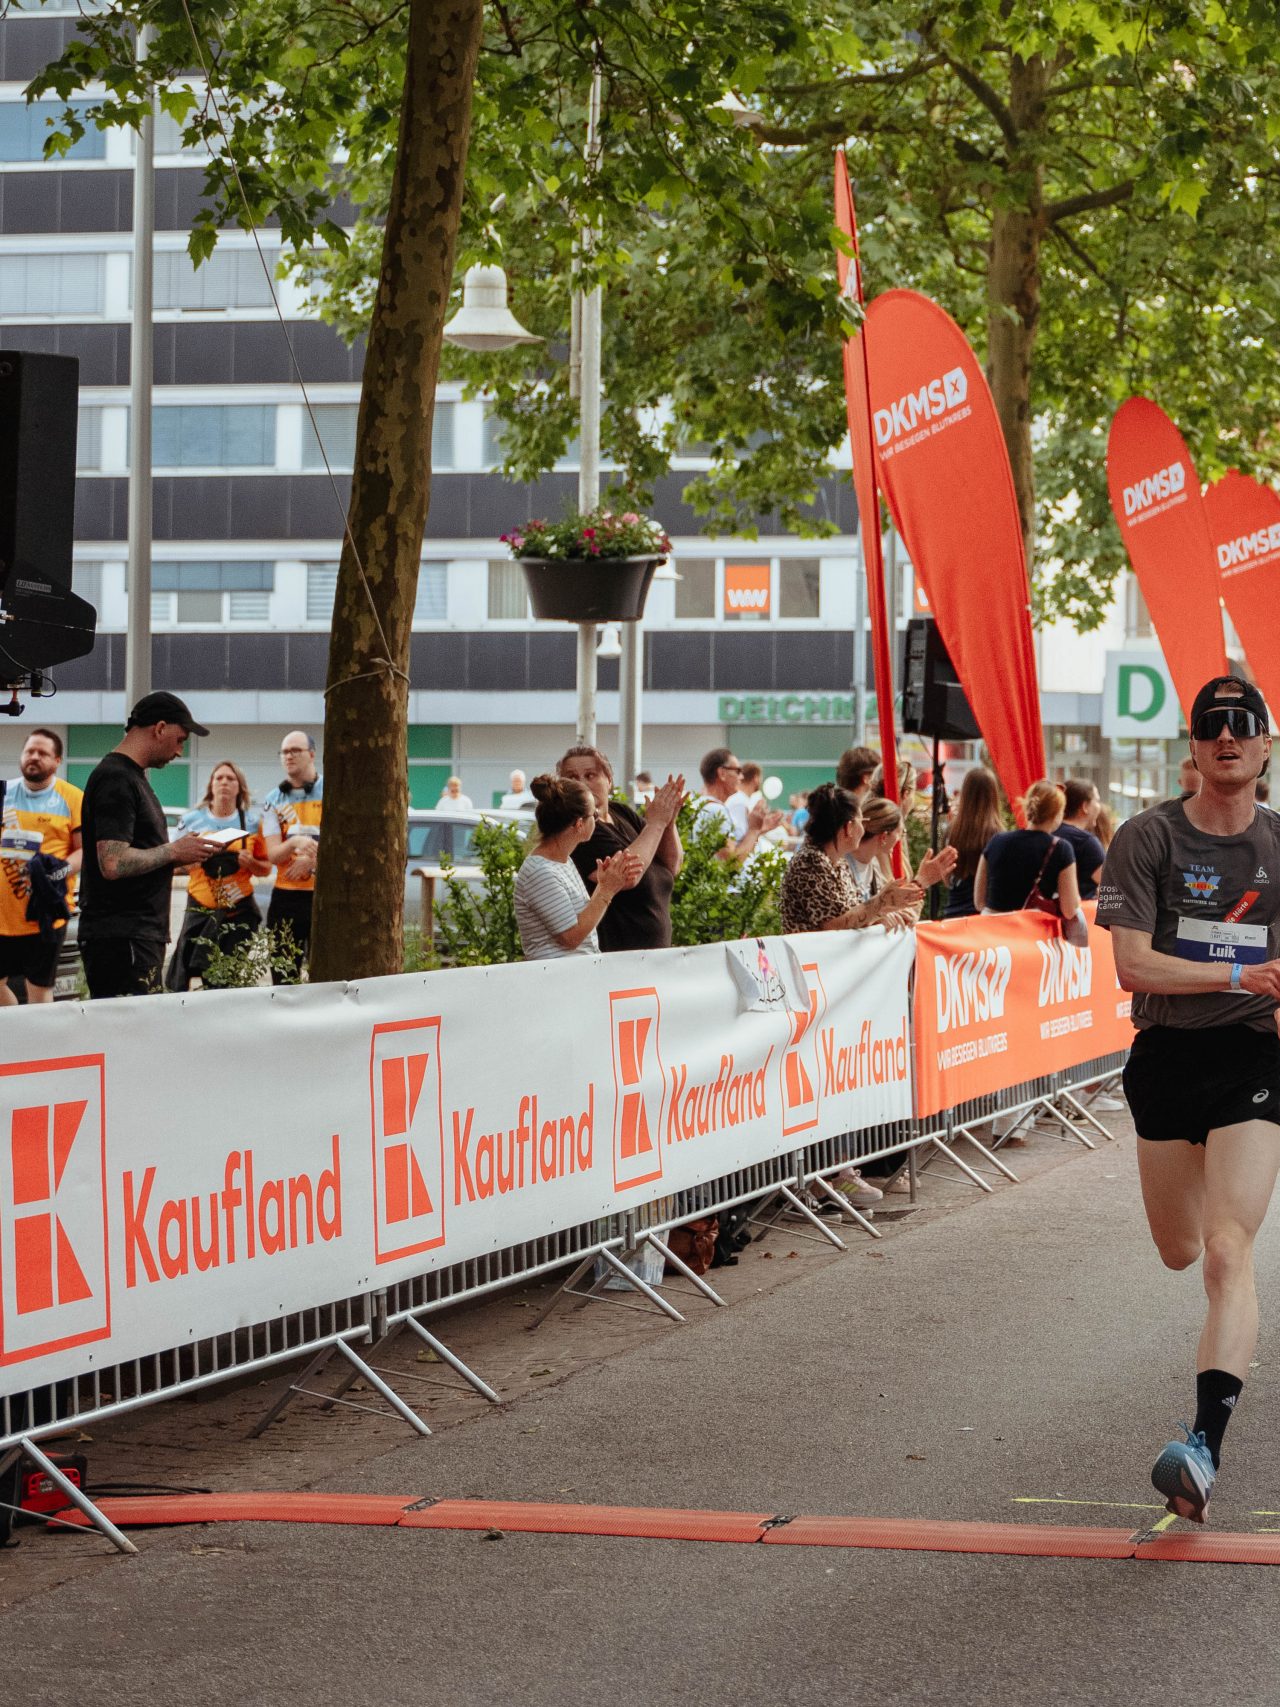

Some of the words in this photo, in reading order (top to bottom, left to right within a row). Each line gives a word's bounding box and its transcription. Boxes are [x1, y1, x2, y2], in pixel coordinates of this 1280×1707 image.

[873, 379, 946, 446] DKMS
[1123, 468, 1171, 516] DKMS
[1217, 529, 1270, 569] DKMS
[1117, 665, 1167, 722] D
[1189, 864, 1215, 873] TEAM
[1098, 902, 1123, 910] cancer
[1036, 939, 1080, 1008] DKMS
[1208, 944, 1237, 959] Luik
[934, 948, 993, 1034] DKMS
[822, 1015, 908, 1098] Kaufland
[667, 1045, 774, 1145] Kaufland
[452, 1083, 595, 1206] Kaufland
[123, 1134, 343, 1289] Kaufland
